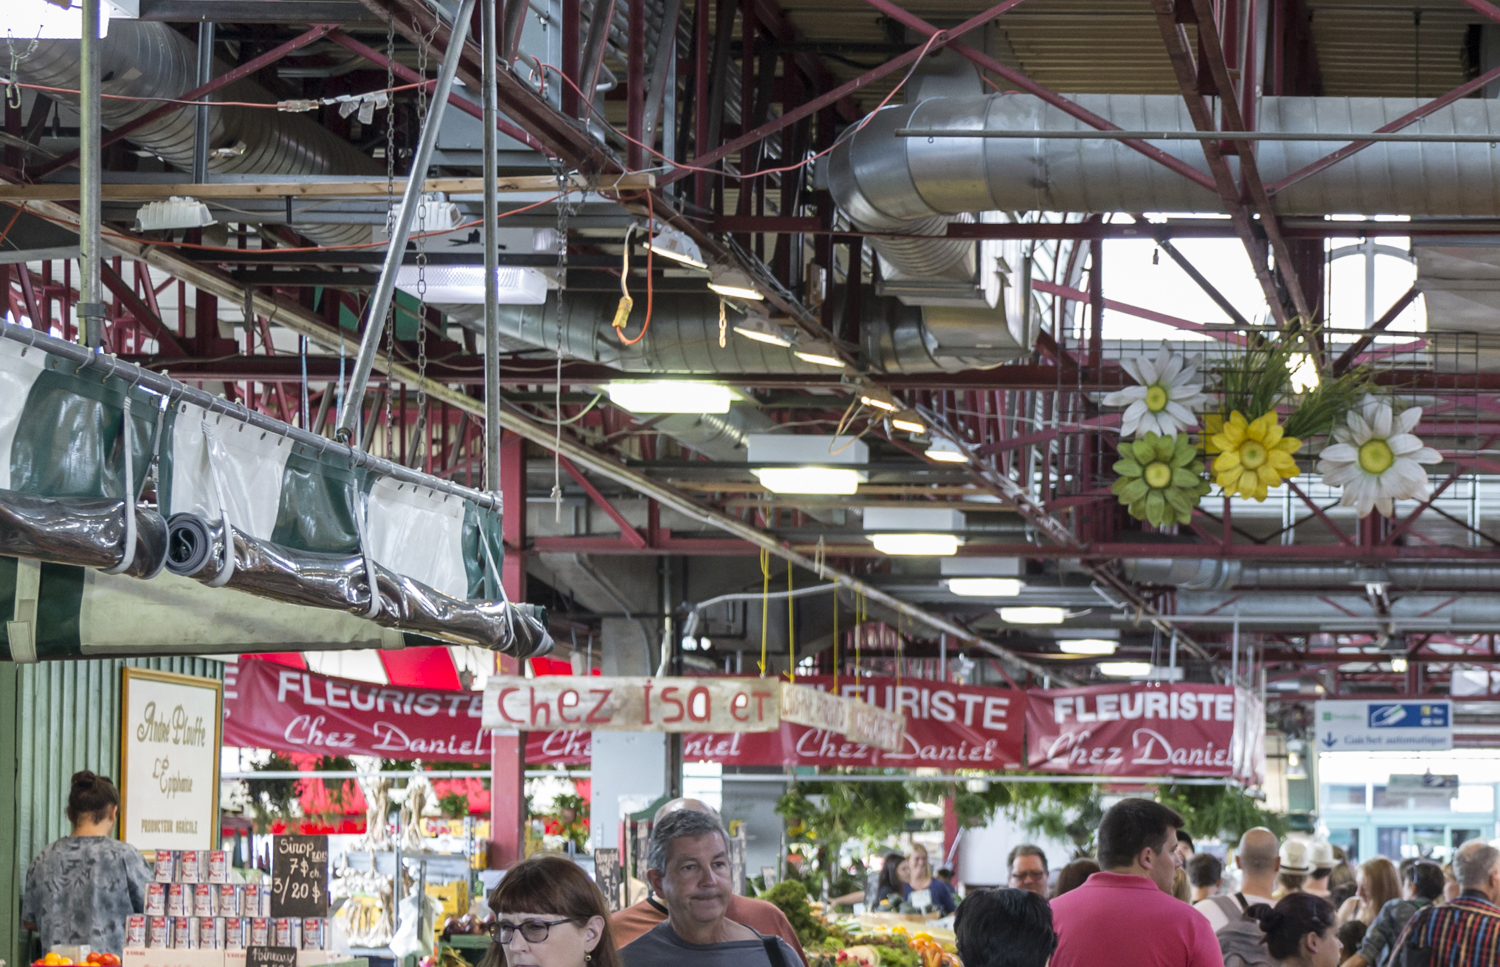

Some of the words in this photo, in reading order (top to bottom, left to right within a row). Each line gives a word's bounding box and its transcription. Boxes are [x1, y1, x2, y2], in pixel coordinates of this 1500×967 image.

[278, 671, 483, 718] FLEURISTE
[497, 685, 613, 727] Chez
[797, 684, 1010, 731] EURISTE
[1053, 692, 1234, 724] FLEURISTE
[137, 701, 171, 743] André
[172, 704, 206, 747] Plouffe
[285, 714, 357, 747] Chez
[371, 720, 489, 757] Daniel
[542, 729, 592, 756] Che
[796, 727, 869, 758] Chez
[1047, 730, 1124, 765] Chez
[1131, 727, 1236, 766] Daniel
[141, 819, 174, 834] PRODUCTEUR
[279, 837, 315, 858] Sirop
